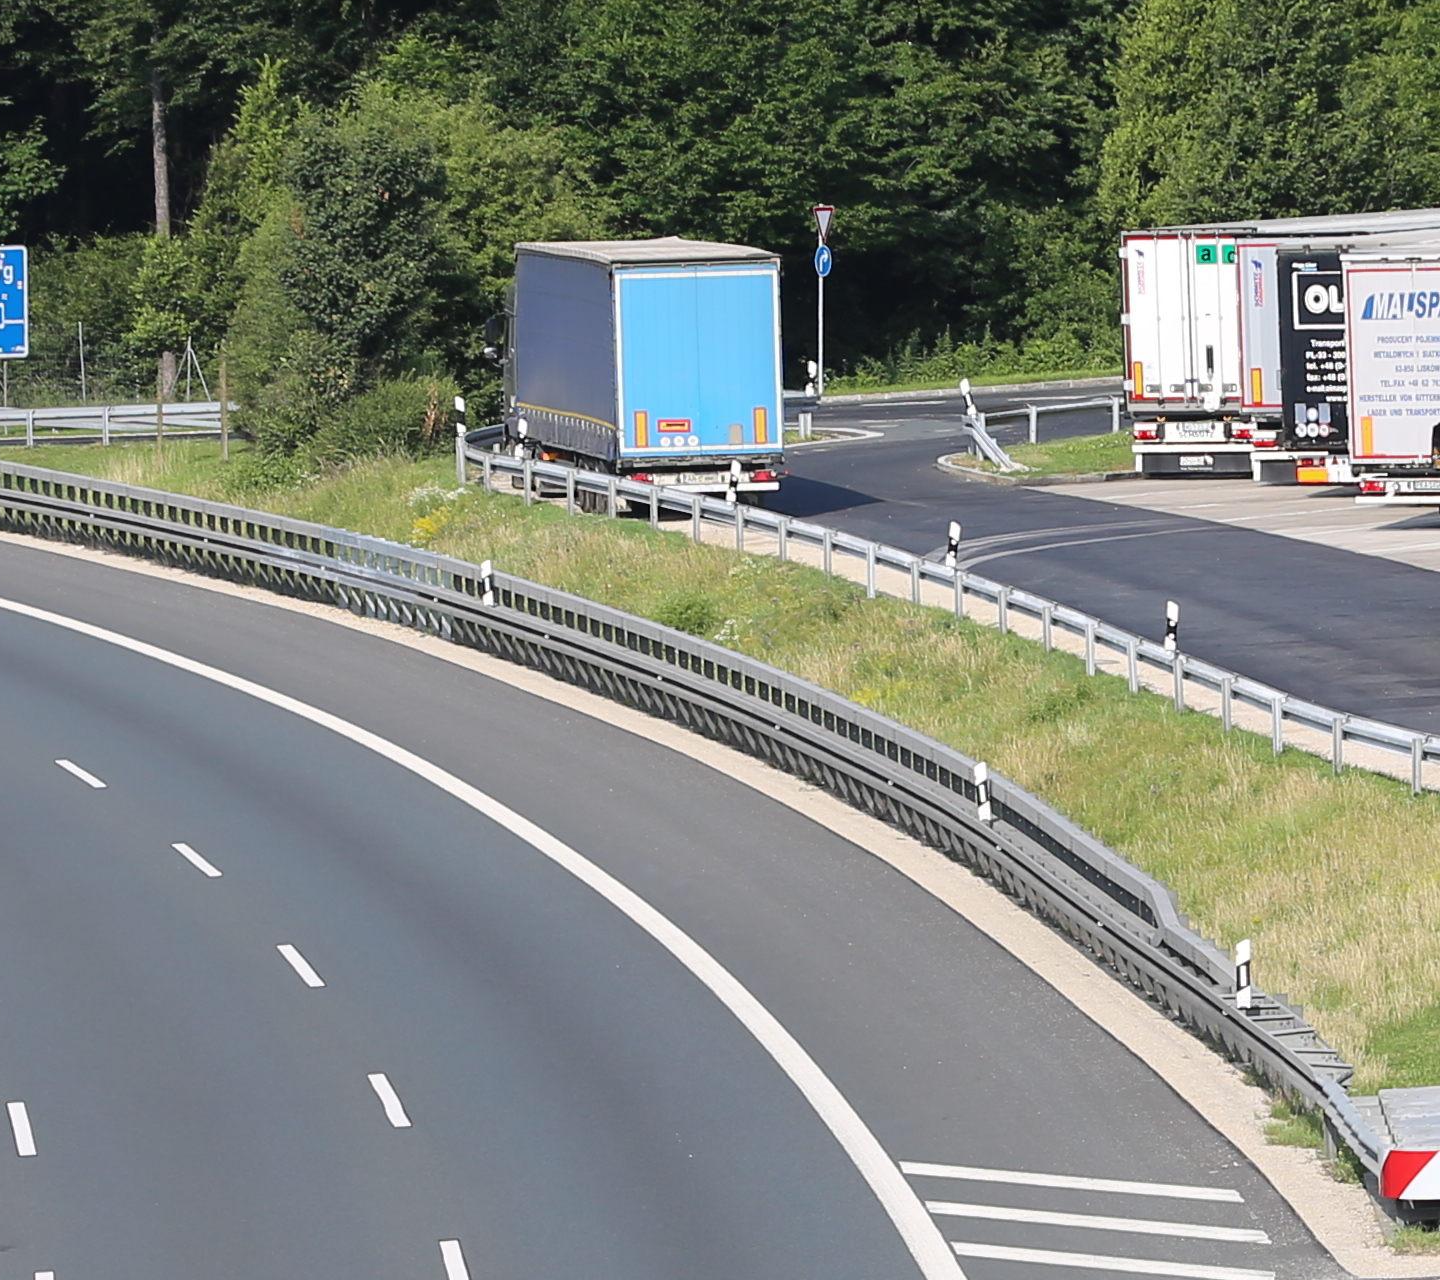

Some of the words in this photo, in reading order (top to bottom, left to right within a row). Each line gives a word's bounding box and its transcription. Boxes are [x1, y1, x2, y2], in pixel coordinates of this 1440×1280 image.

[1201, 248, 1211, 261] a
[1377, 336, 1413, 344] PRODUCENT
[1359, 394, 1397, 402] HERSTELLER
[1399, 394, 1412, 402] VON
[1367, 408, 1387, 417] LAGER
[1390, 408, 1403, 416] UND
